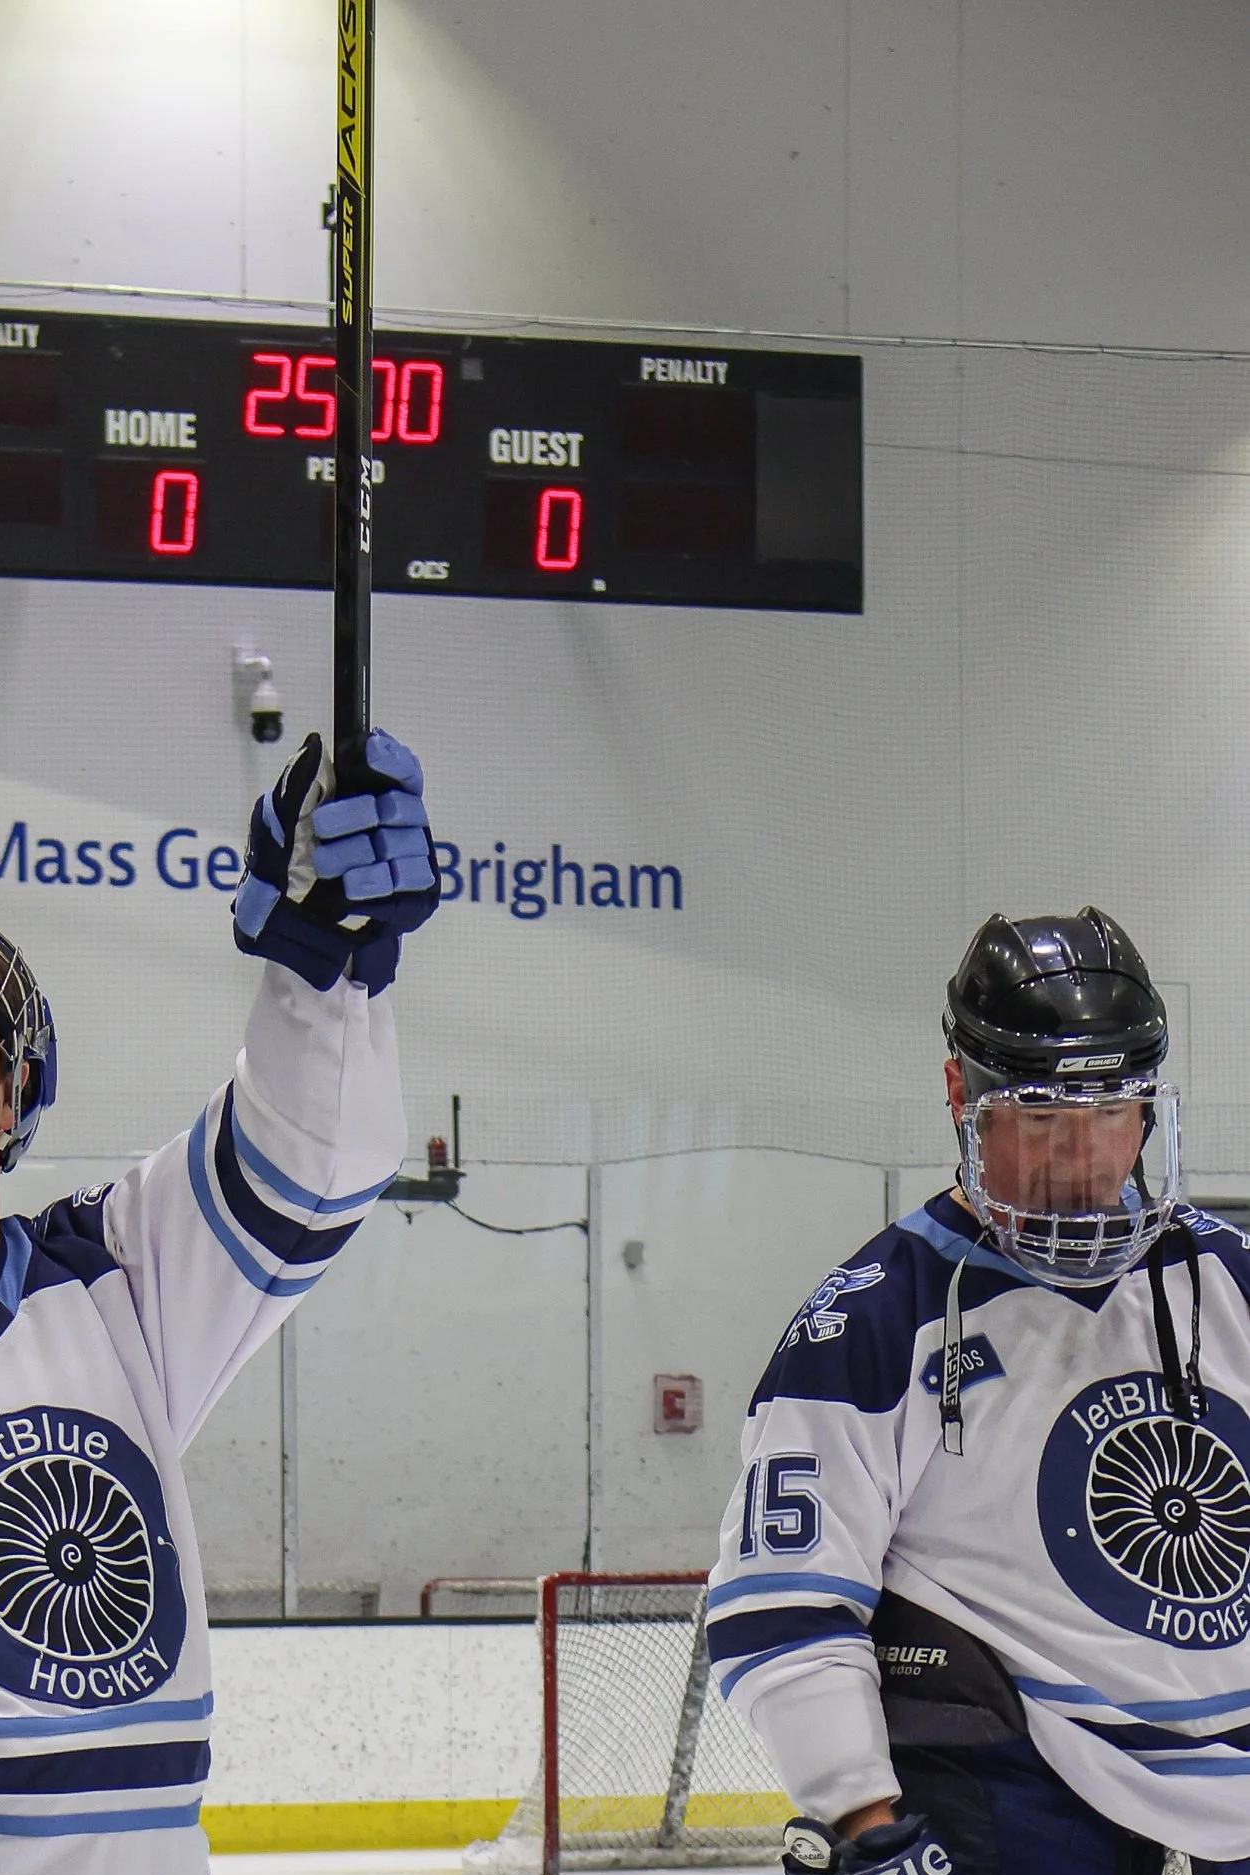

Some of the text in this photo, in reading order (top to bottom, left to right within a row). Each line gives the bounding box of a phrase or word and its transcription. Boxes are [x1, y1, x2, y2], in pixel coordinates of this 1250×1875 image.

[341, 196, 354, 326] SUPER
[640, 357, 728, 386] PENALTY
[105, 409, 197, 450] HOME
[489, 428, 584, 469] GUEST
[306, 456, 386, 484] PED
[359, 455, 372, 554] CCM
[151, 471, 198, 554] 0
[537, 489, 581, 570] 0
[437, 841, 684, 920] Brigham
[960, 1349, 985, 1375] OS
[739, 1452, 822, 1561] 15
[29, 1637, 171, 1699] HOCKEY
